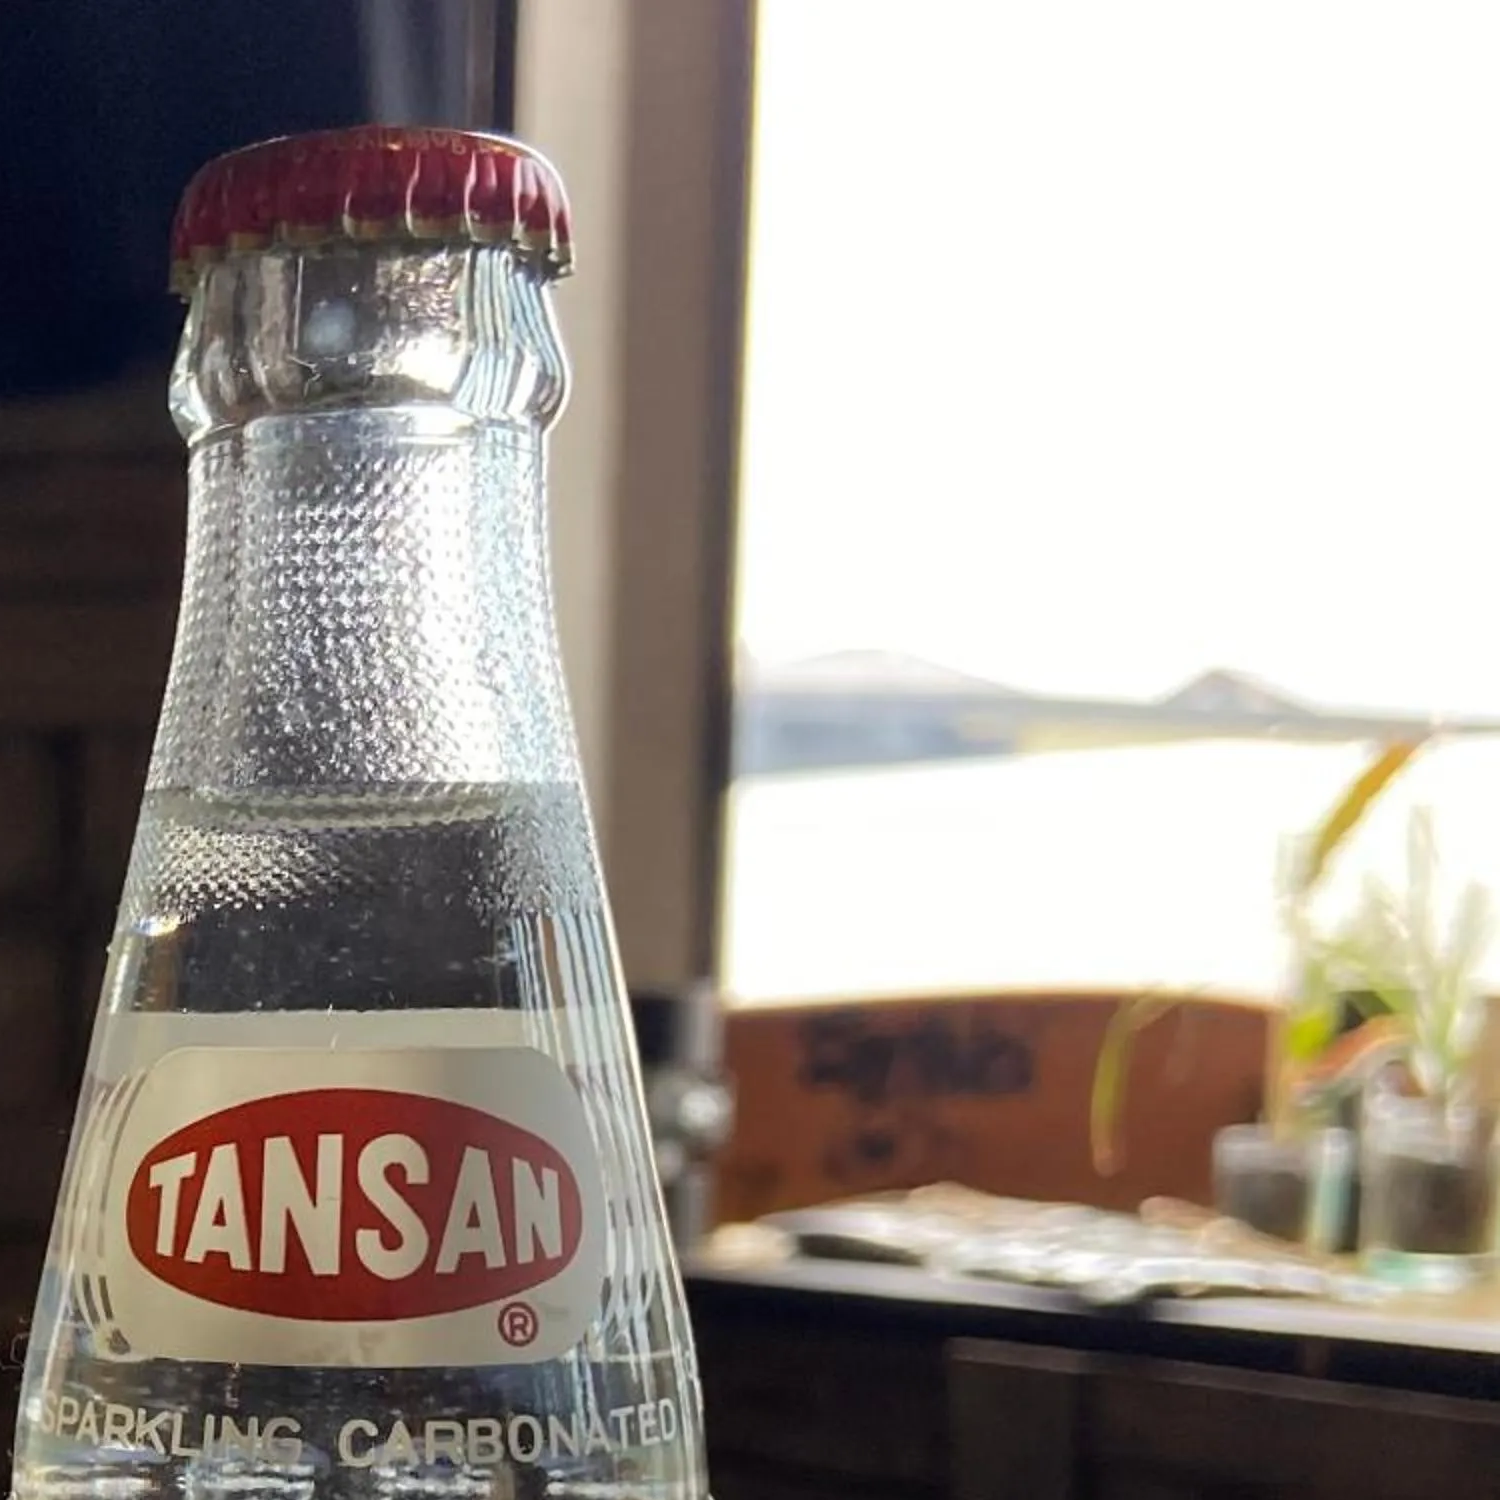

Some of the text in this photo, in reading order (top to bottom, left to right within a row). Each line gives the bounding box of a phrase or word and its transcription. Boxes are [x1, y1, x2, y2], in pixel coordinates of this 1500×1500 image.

[147, 1132, 563, 1281] TANSAN
[40, 1396, 678, 1468] SPARKLING CARBONATED
